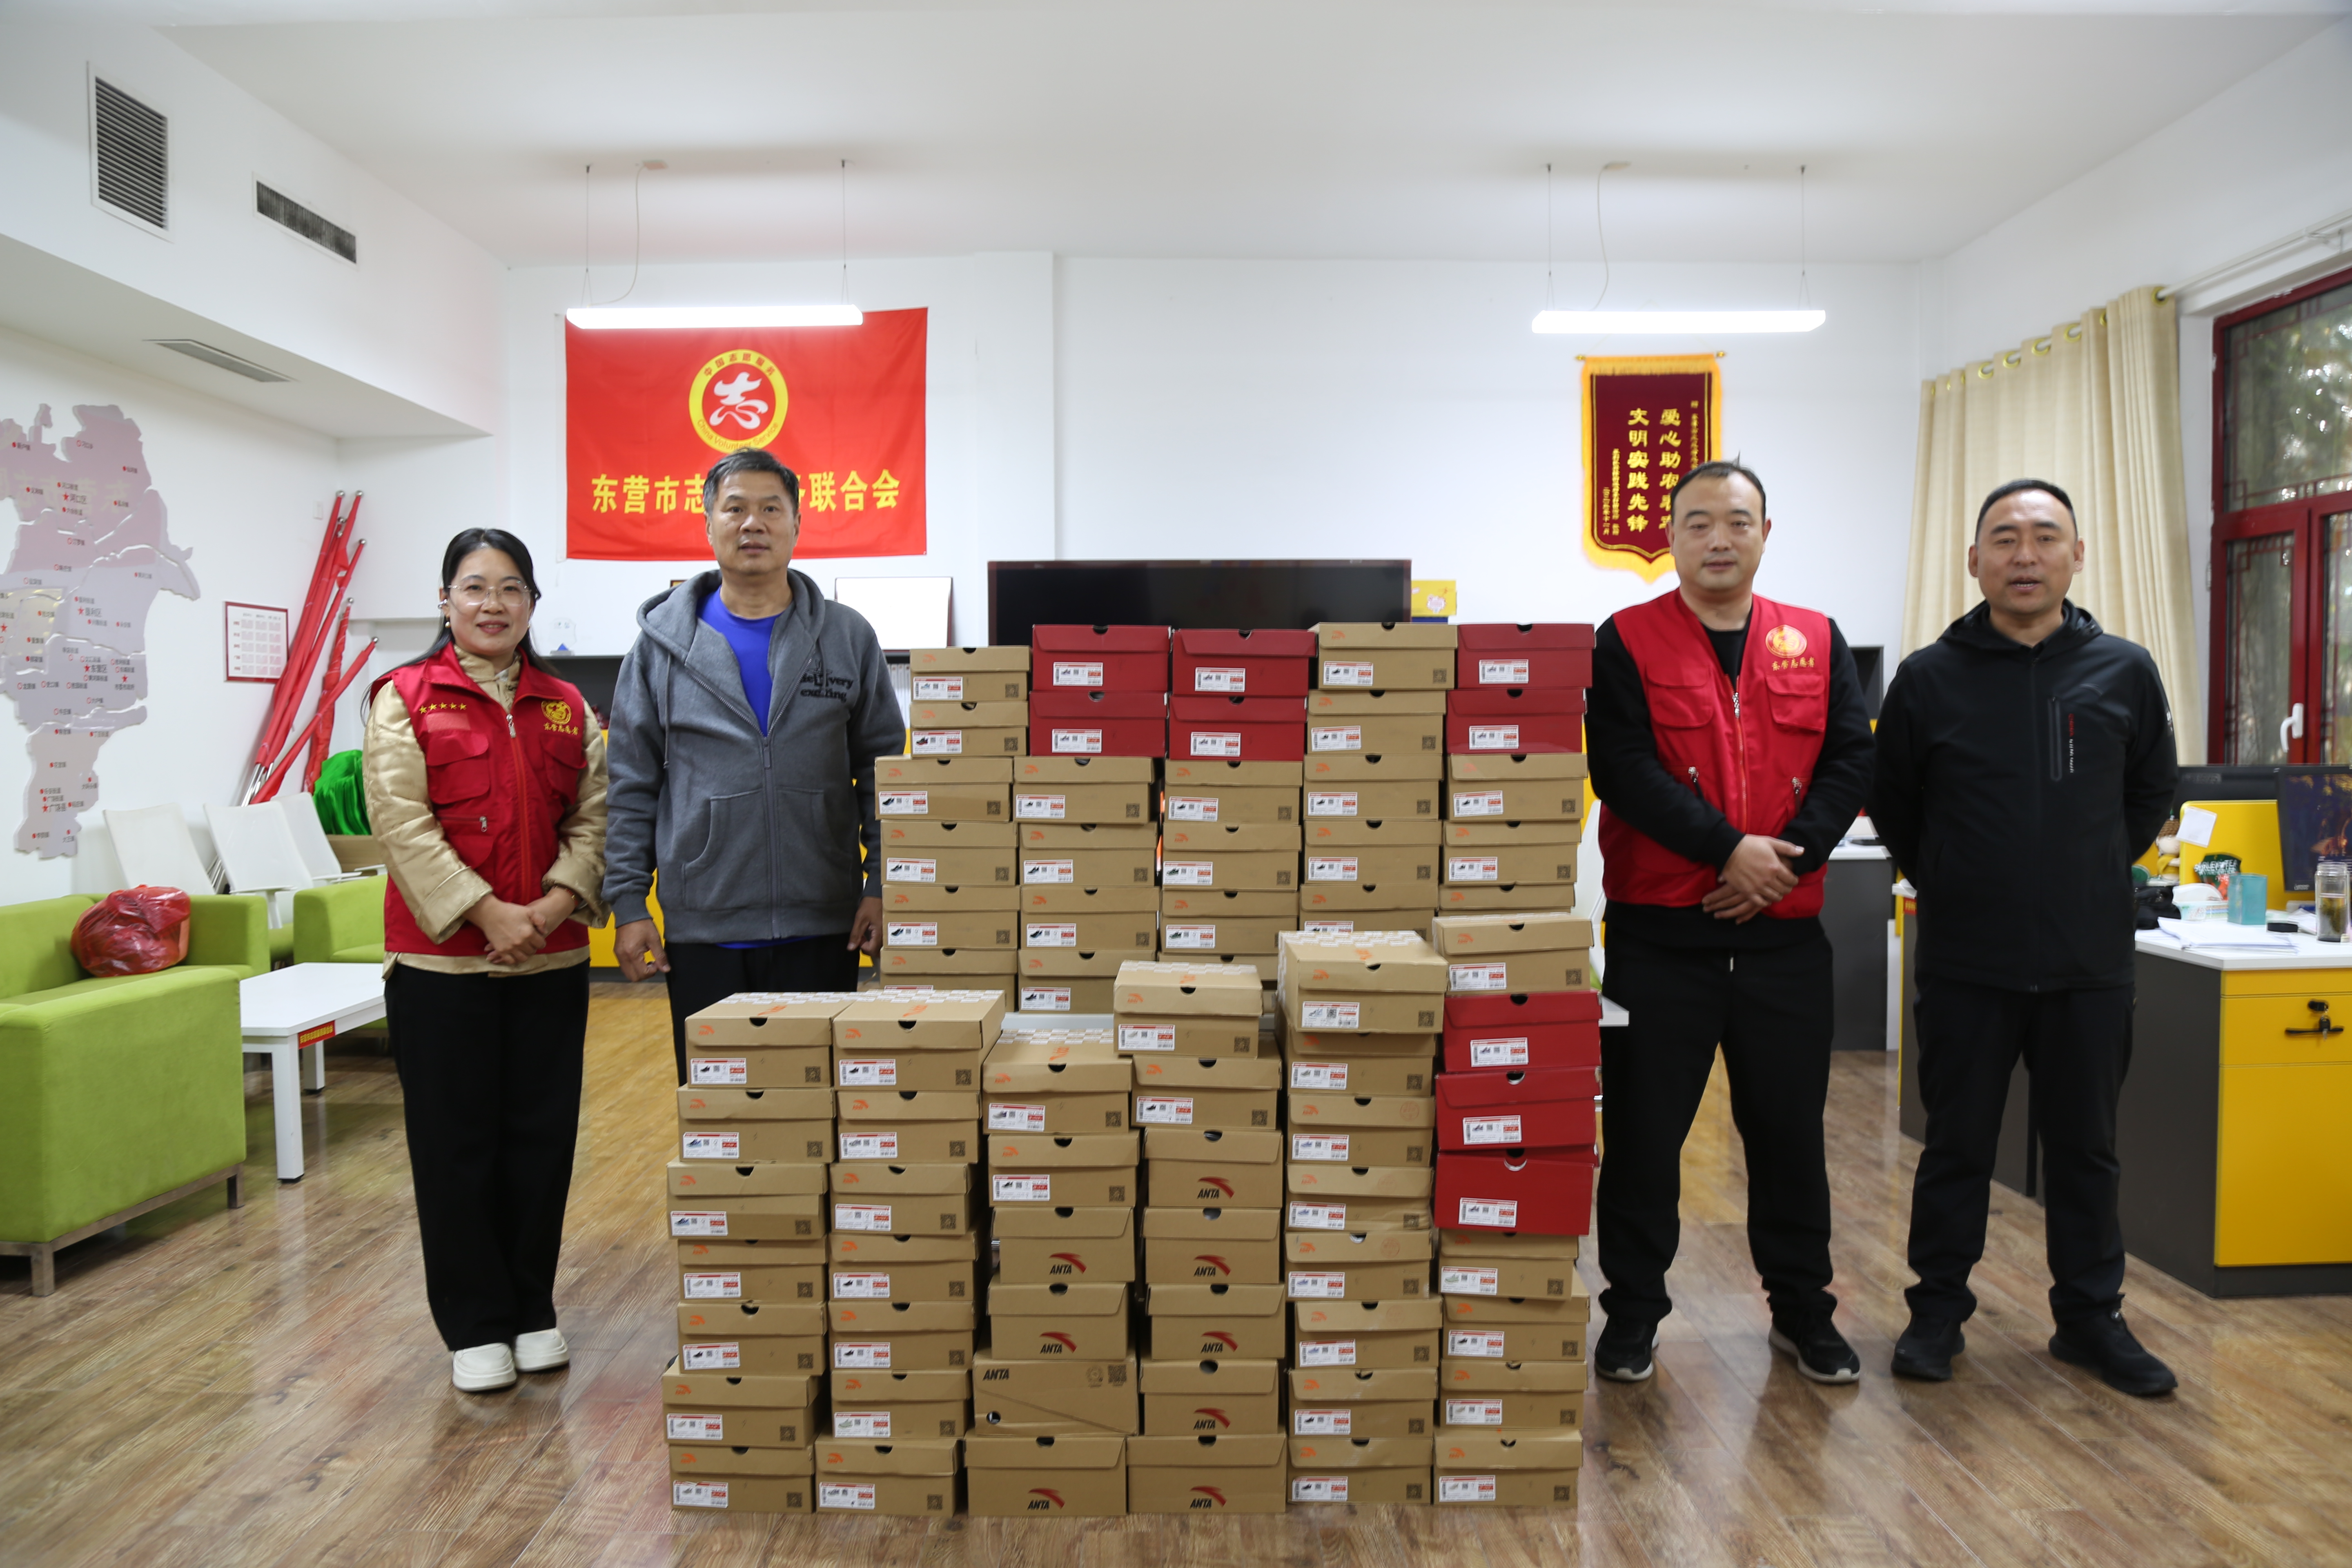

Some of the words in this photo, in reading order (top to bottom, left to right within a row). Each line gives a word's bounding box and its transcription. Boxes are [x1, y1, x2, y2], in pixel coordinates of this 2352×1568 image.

[704, 352, 775, 377] 中国志愿服务
[697, 418, 714, 441] China
[753, 421, 779, 445] Service
[1627, 408, 1650, 533] 文明实践先锋
[591, 468, 900, 514] 东营市志联合会
[1198, 1189, 1219, 1199] ANTA
[1050, 1265, 1072, 1274] ANTA
[1194, 1267, 1216, 1276] ANTA
[1040, 1344, 1062, 1354] ANTA
[1201, 1343, 1223, 1353] ANTA
[982, 1369, 1009, 1381] ANTA
[1193, 1420, 1216, 1430] ANTA
[1027, 1500, 1050, 1510] ANTA
[1190, 1499, 1212, 1509] ANTA
